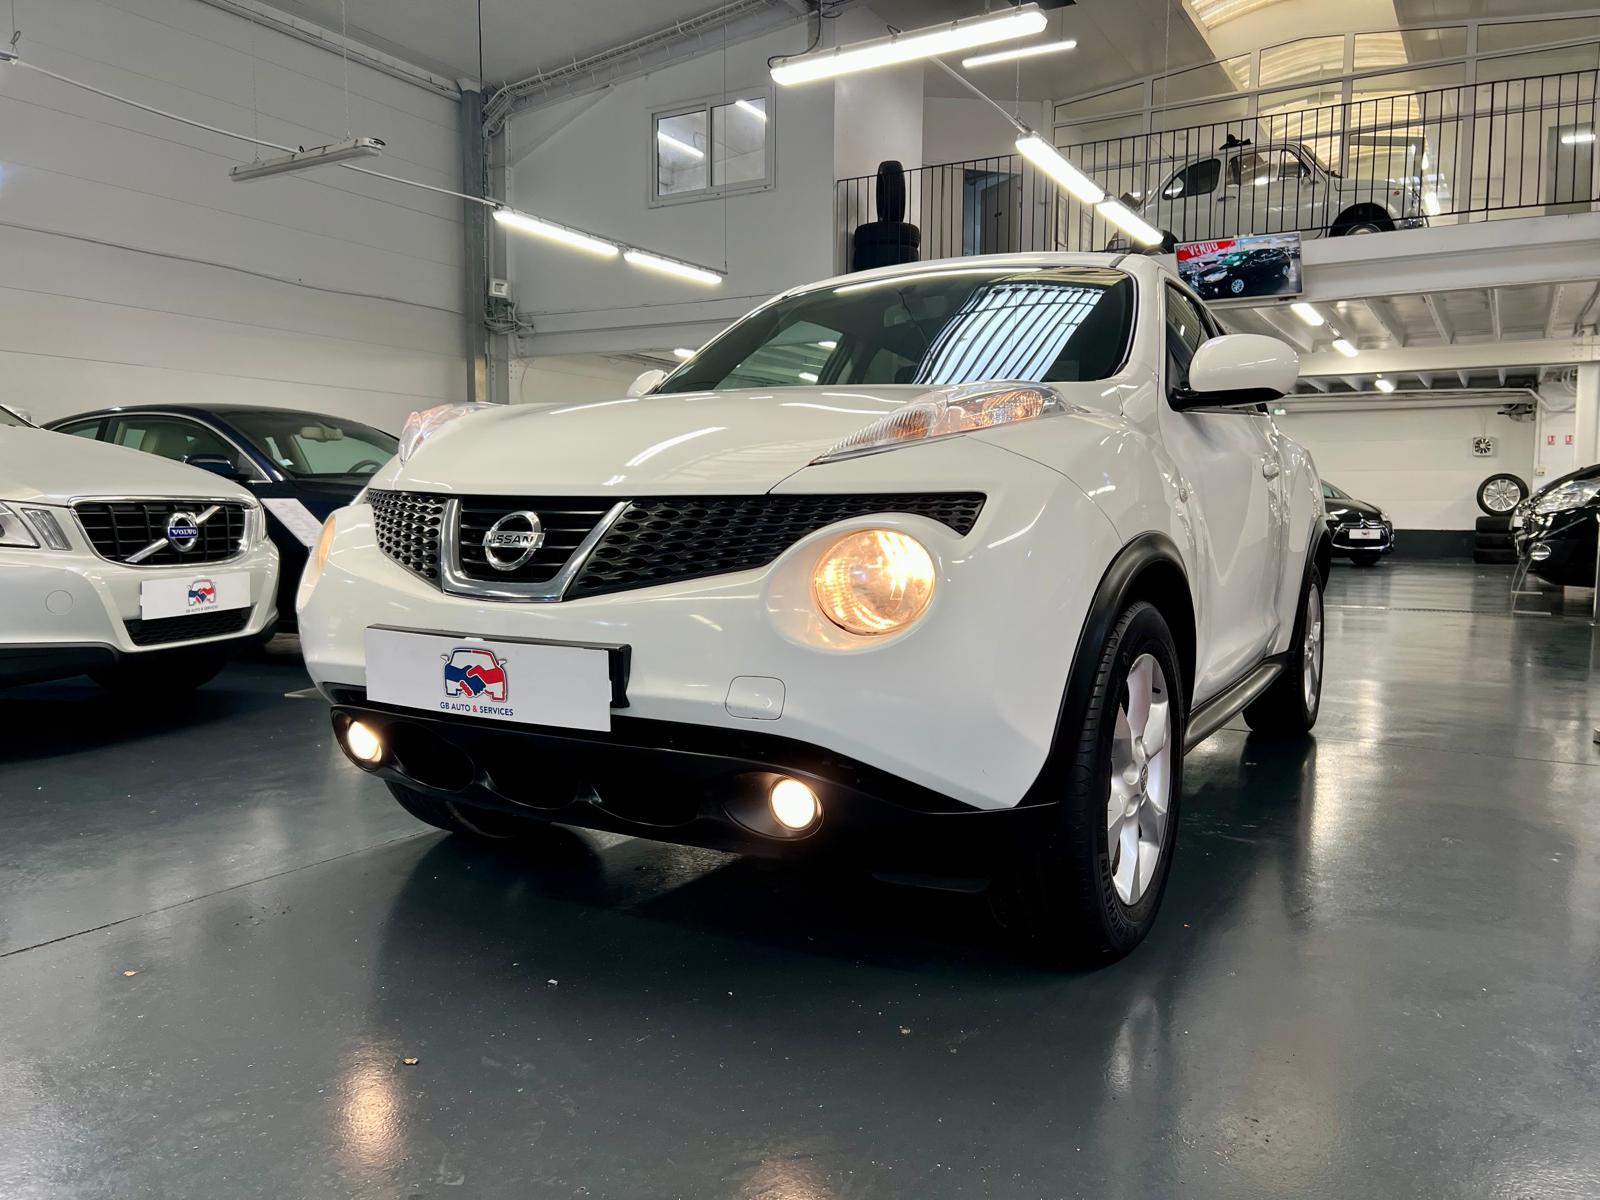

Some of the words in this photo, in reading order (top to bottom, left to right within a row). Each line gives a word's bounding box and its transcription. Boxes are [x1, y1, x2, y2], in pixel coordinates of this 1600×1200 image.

[1188, 242, 1219, 257] VENDU
[485, 534, 533, 544] NISSAN
[440, 701, 450, 709] GB
[451, 703, 471, 712] AUTO
[472, 705, 478, 713] &
[479, 705, 514, 716] SERVICES
